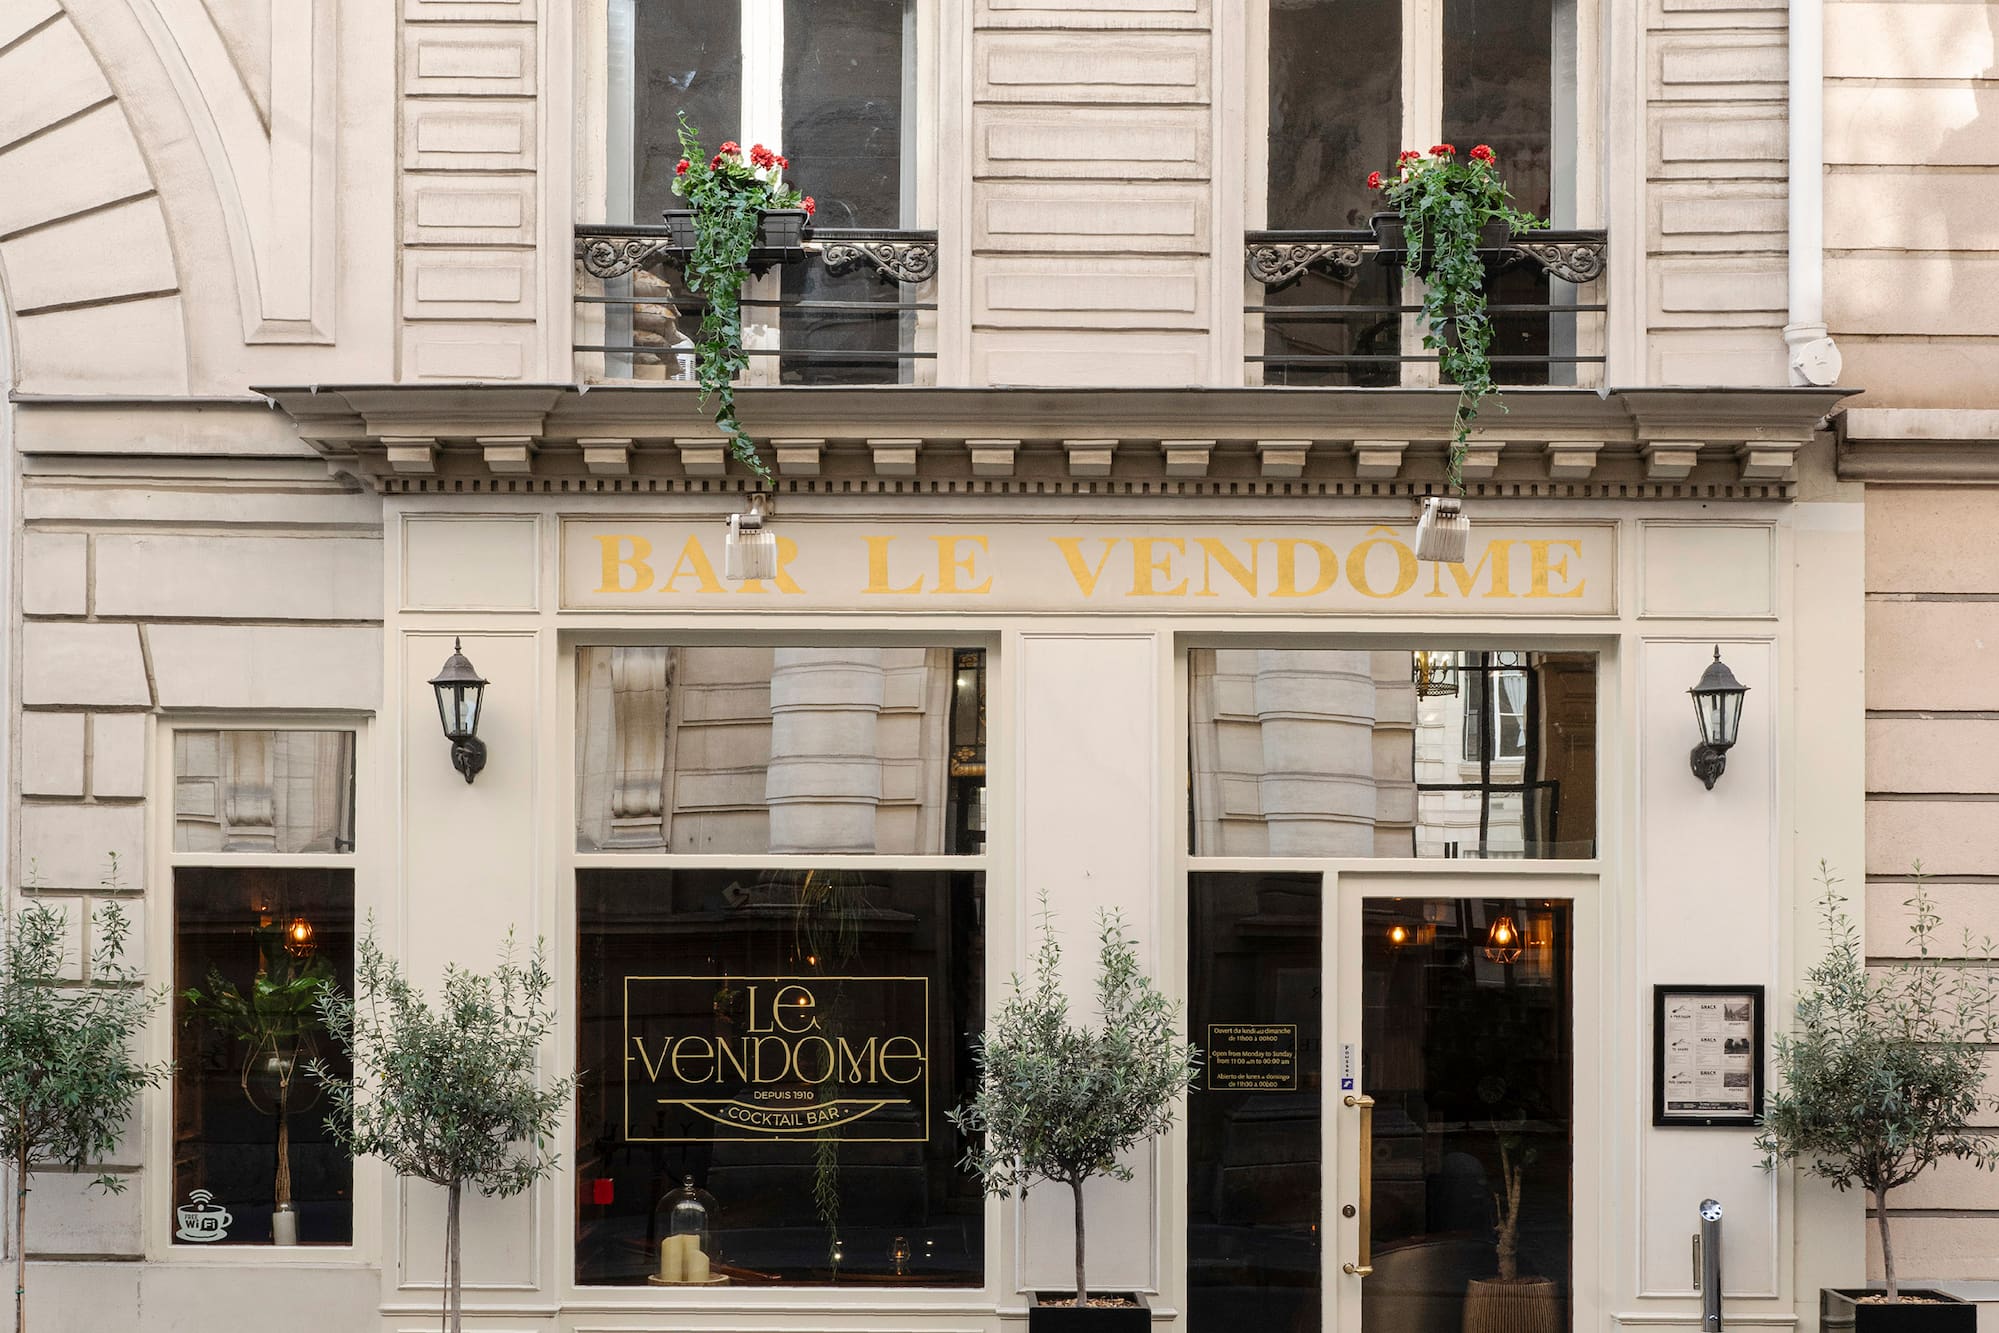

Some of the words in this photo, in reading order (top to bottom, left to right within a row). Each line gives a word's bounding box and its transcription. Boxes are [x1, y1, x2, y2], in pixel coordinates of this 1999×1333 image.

[859, 534, 993, 595] LE
[1048, 525, 1586, 599] VENDÔME
[1211, 1050, 1228, 1058] Open
[753, 1090, 792, 1100] DEPUIS
[792, 1090, 815, 1100] 1910
[728, 1106, 804, 1127] COCKTAIL
[806, 1107, 840, 1125] BAR
